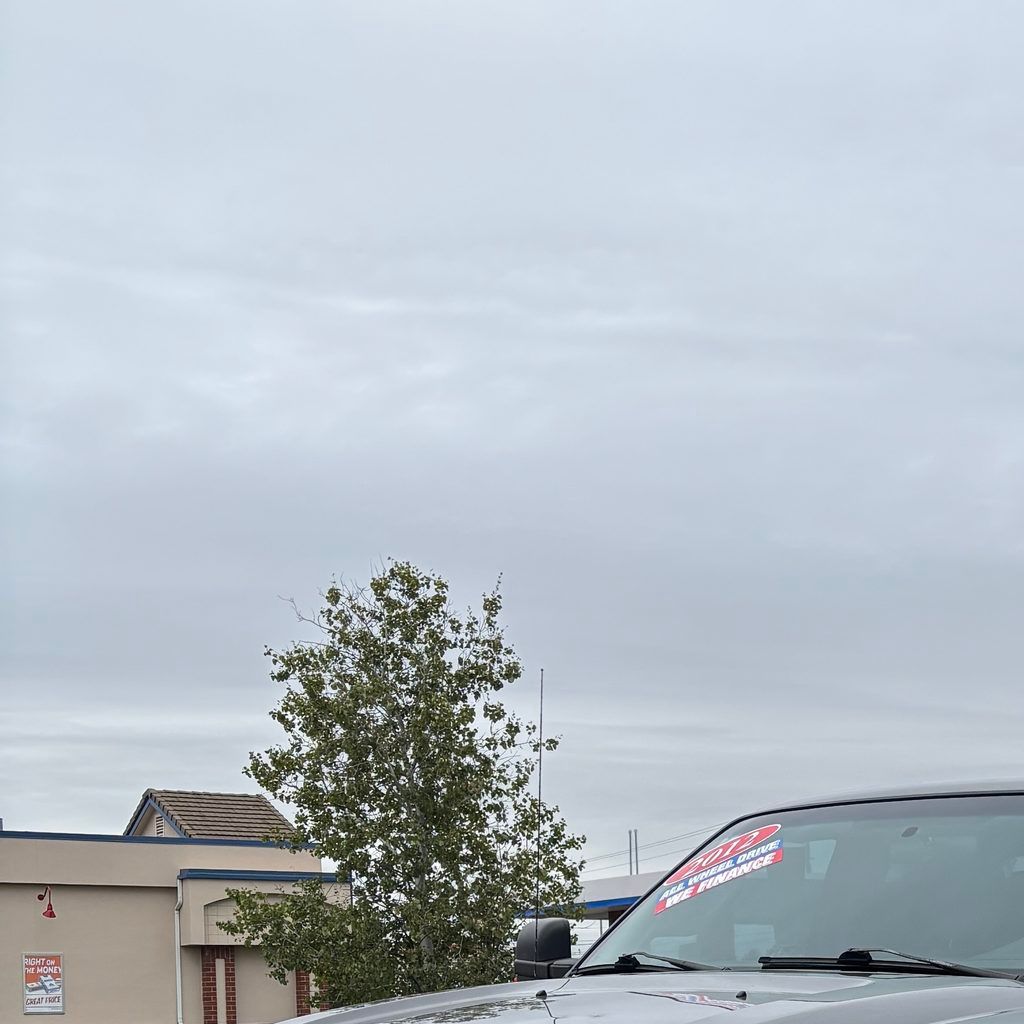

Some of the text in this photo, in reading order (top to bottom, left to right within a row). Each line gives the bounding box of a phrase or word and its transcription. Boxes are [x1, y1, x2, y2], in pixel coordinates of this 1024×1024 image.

[682, 832, 760, 877] 2012
[688, 859, 735, 885] WHEEL
[736, 840, 781, 865] DRIVE
[665, 852, 776, 908] WE FINANCE
[24, 958, 45, 966] RIGHT
[36, 966, 62, 974] MONEY
